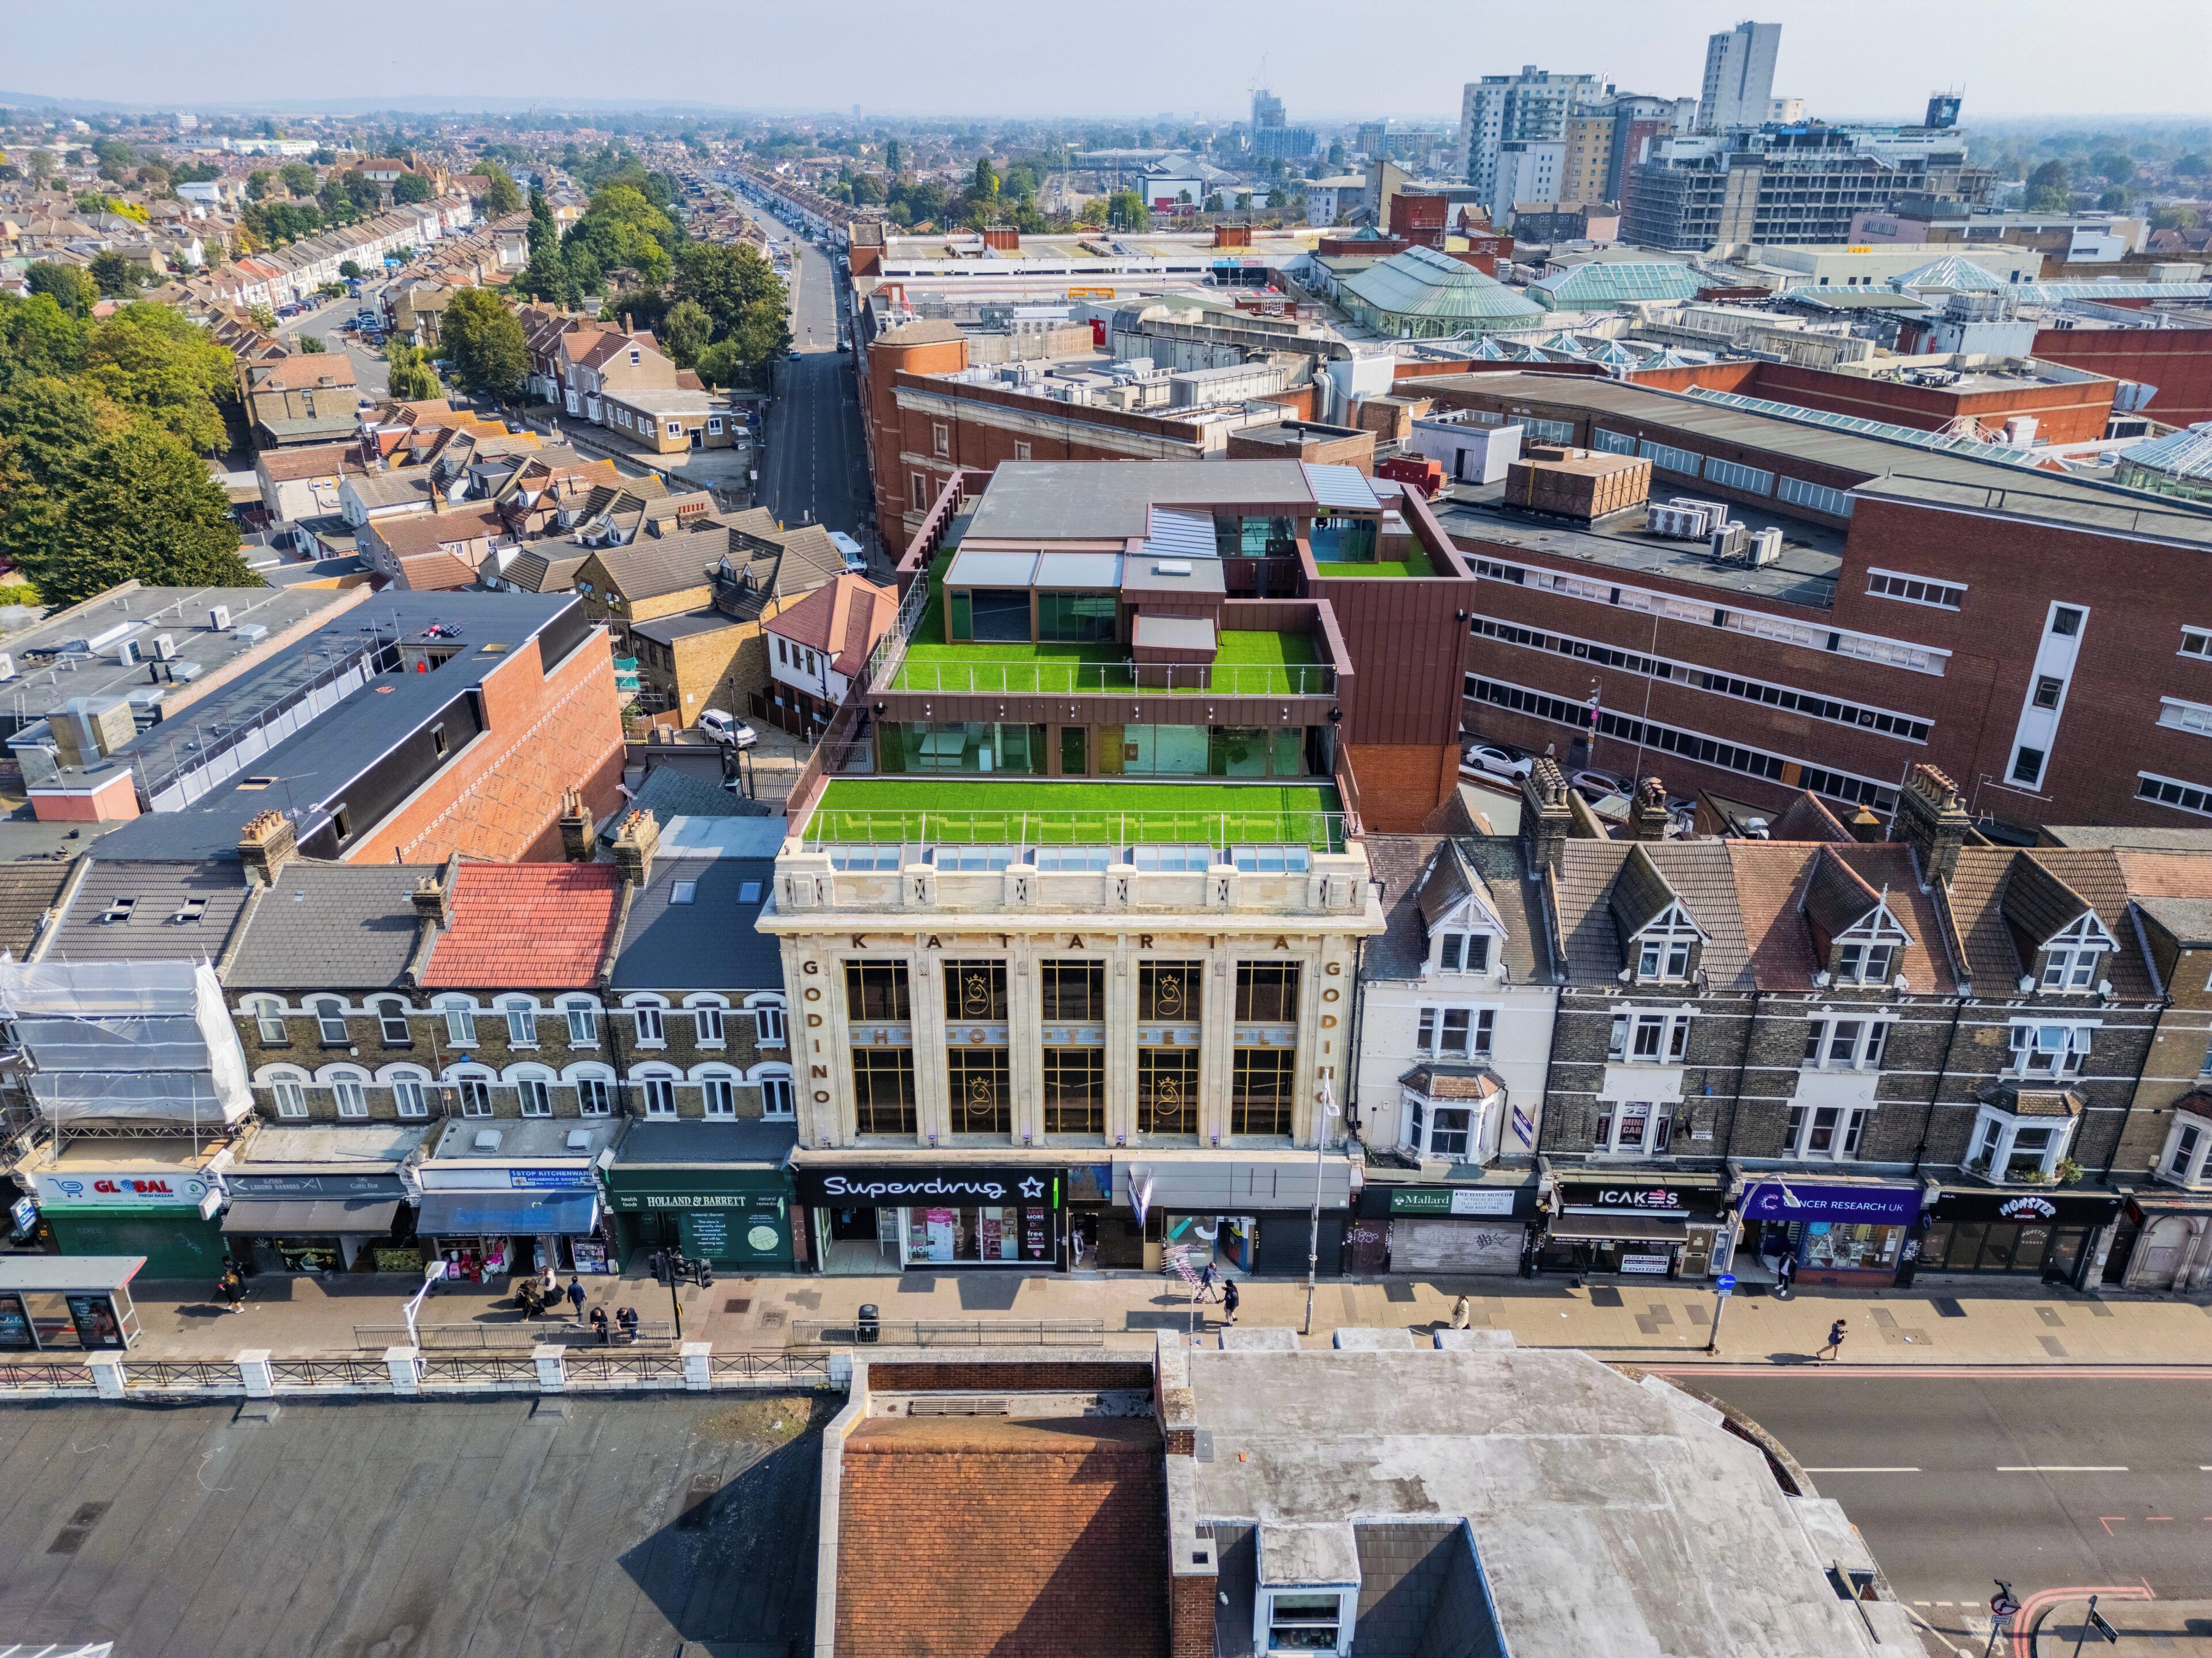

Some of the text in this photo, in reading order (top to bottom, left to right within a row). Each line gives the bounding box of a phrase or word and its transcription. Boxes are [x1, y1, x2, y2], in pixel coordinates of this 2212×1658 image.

[852, 934, 1290, 950] KATARIA
[803, 961, 830, 1104] GODINO
[1623, 1118, 1643, 1126] MINI
[823, 1177, 1007, 1199] Superdrug
[647, 1196, 745, 1207] HOLLAND & BARRETT
[1406, 1196, 1449, 1204] Mallard
[1783, 1200, 1904, 1212] CNCER RESEARCH UK
[1999, 1197, 2056, 1219] MONSTER
[2021, 1230, 2048, 1239] MONSTER
